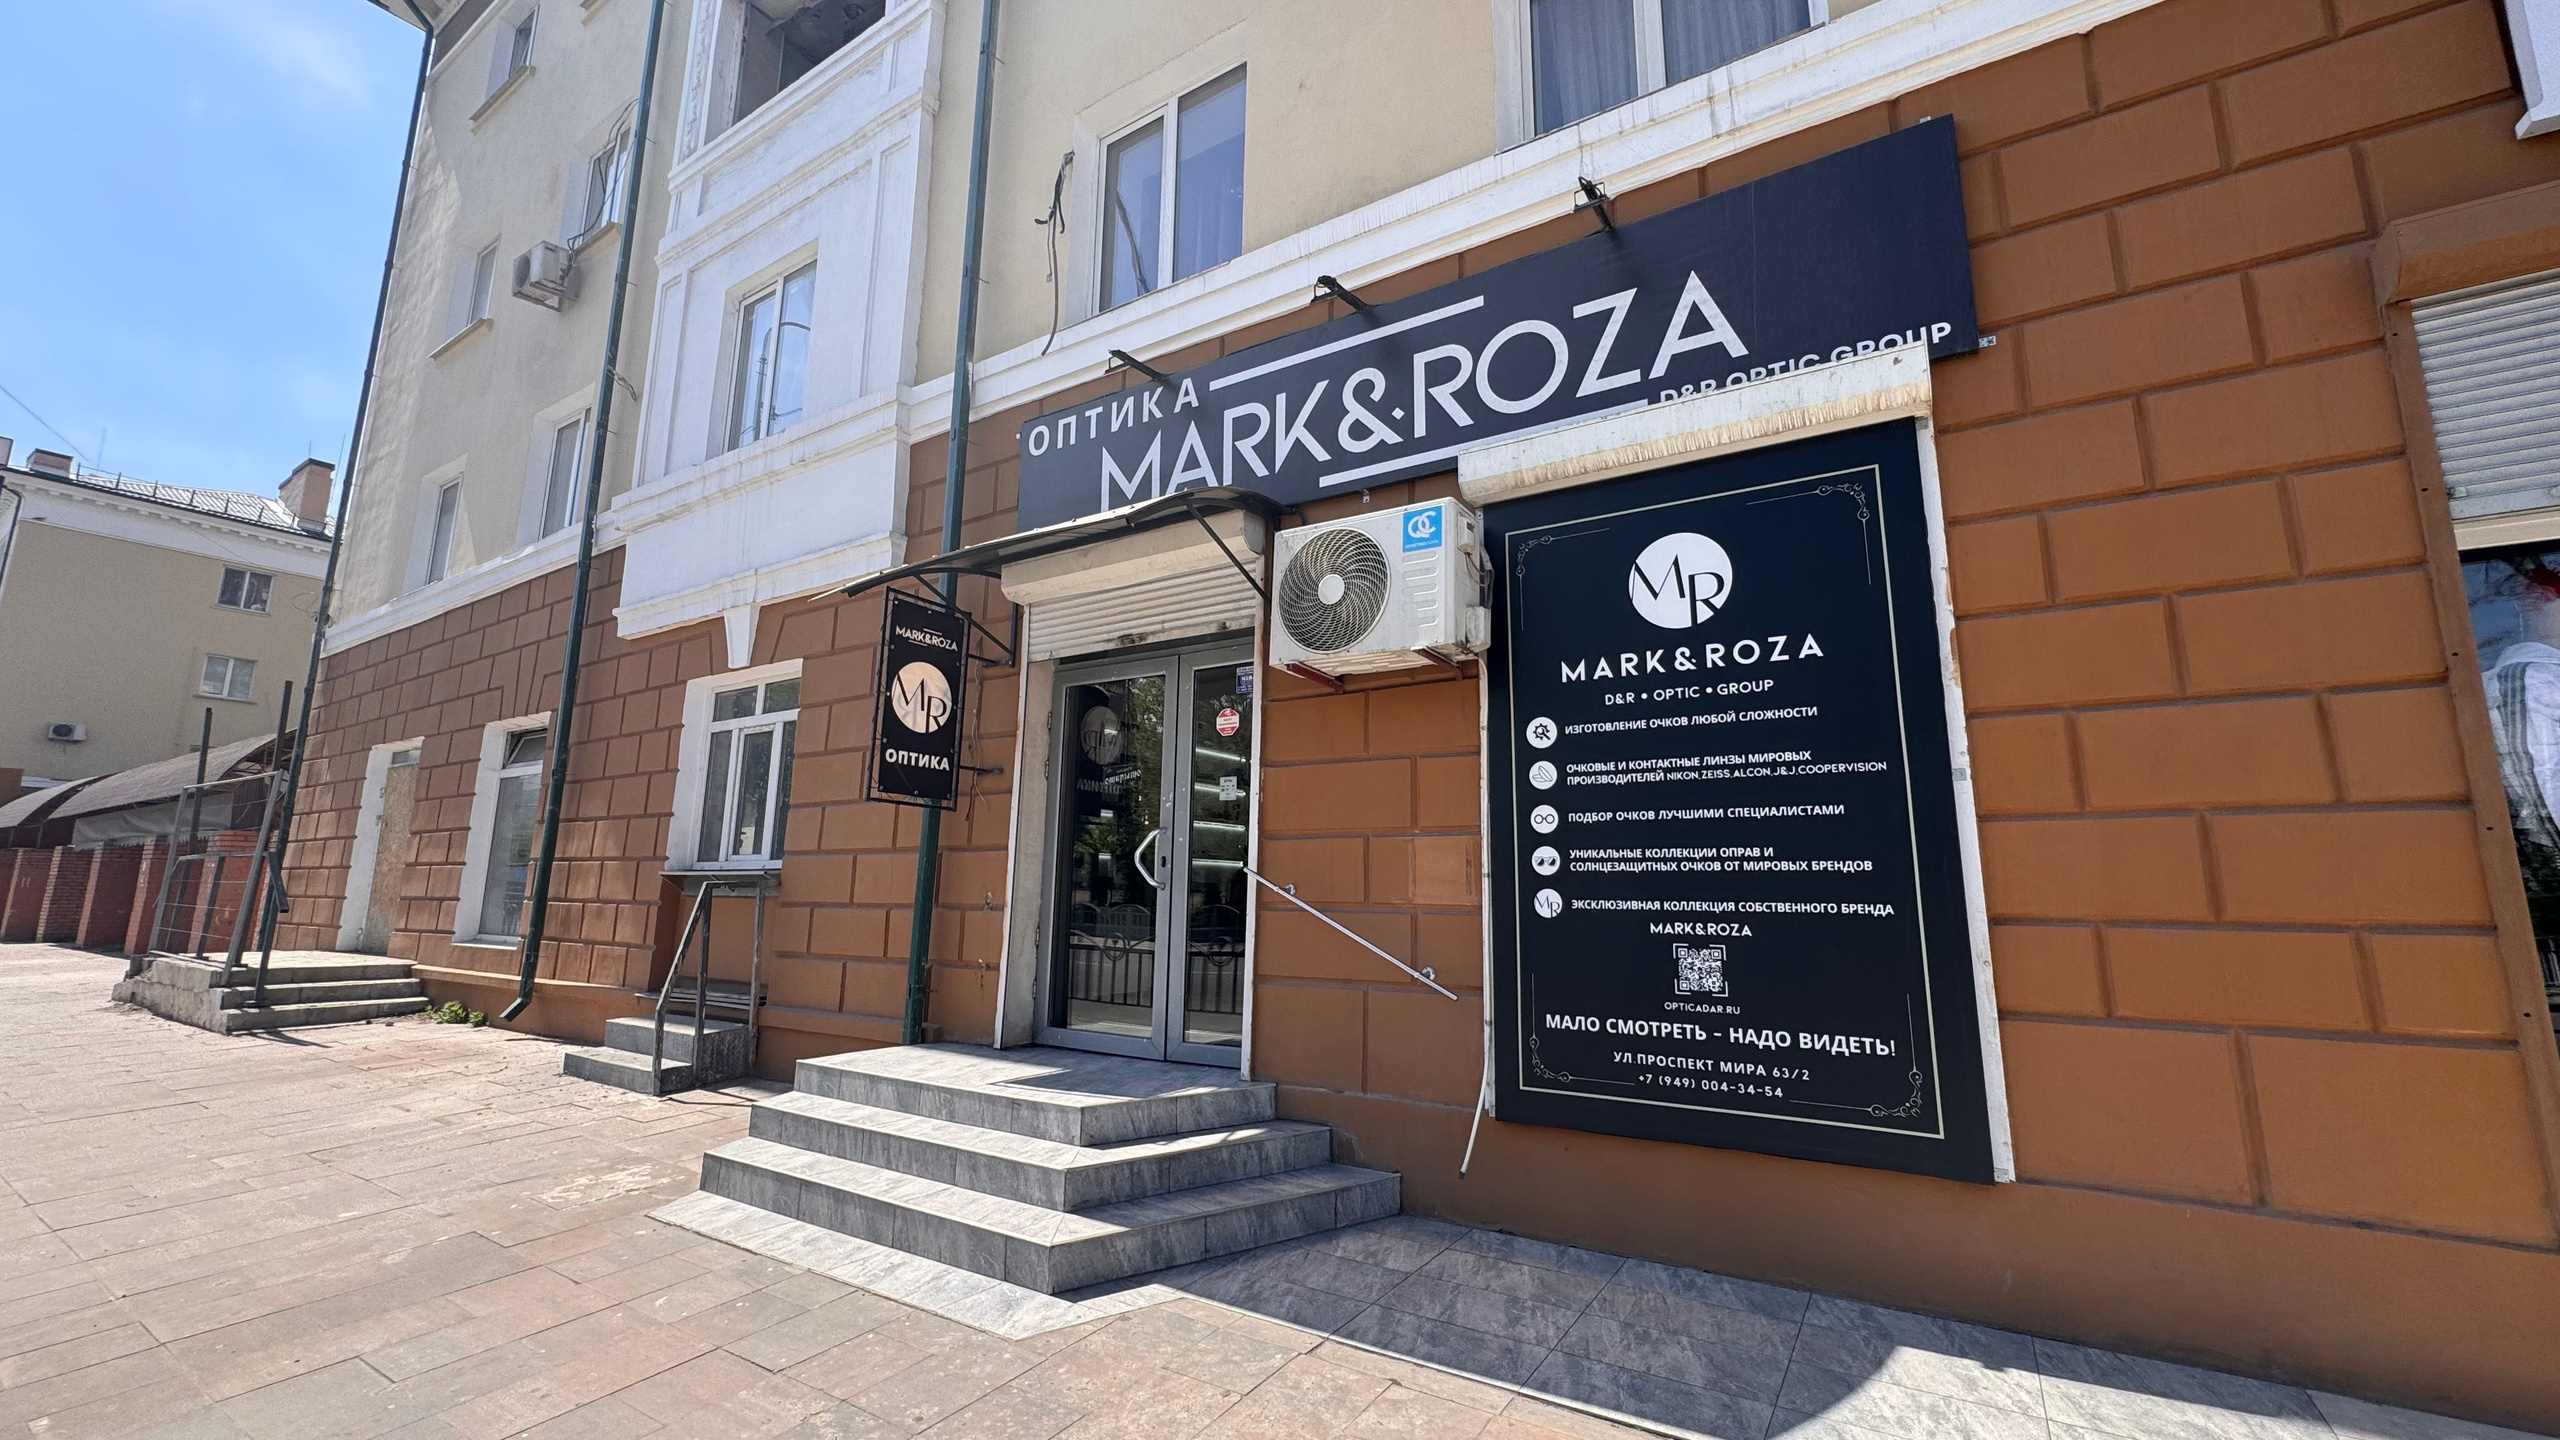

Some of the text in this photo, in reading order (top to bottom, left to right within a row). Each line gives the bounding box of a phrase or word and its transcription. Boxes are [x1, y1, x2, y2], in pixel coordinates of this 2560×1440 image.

[1101, 270, 1750, 513] MARK&ROZA
[1028, 377, 1199, 457] ОПТИКА
[895, 624, 958, 652] MARK&ROZA
[1561, 633, 1824, 683] MARK&ROZA
[1604, 679, 1774, 706] D&R OPTIC GROUP
[1564, 706, 1818, 735] ИЗГОТОВЛЕНИЕ ОЧКОВ ЛЮБОЙ СЛОЖНОСТИ
[885, 748, 950, 771] ОПТИКА
[1566, 750, 1812, 774] ОЧКОВЫЕ И КОНТАКТНЫЕ ЛИНЗЫ МИРОВЫХ
[1566, 770, 1665, 786] ПРОИЗВОДИТЕЛЕЙ
[1568, 804, 1845, 823] ПОДБОР ОЧКОВ ЛУЧШИМИ СПЕЦИАЛИСТАМИ
[1569, 847, 1774, 860] УНИКАЛЬНЫЕ КОЛЛЕКЦИИ ОПРАВ И
[1569, 860, 1873, 874] СОЛНЦЕЗАЩИТНЫХ ОЧКОВ ОТ МИРОВЫХ БРЕНДОВ
[1571, 899, 1895, 917] ЭКСКЛЮЗИВНАЯ КОЛЛЕКЦИЯ СОБСТВЕННОГО БРЕНДА
[1649, 921, 1753, 937] MARK&ROZA
[1663, 1001, 1741, 1016] OPTICADAR.RU
[1545, 1013, 1600, 1033] МАЛО
[1605, 1018, 1707, 1041] СМОТРЕТЬ
[1729, 1026, 1792, 1051] НАДО
[1798, 1032, 1897, 1057] ВИДЕТЬ!
[1719, 1060, 1767, 1077] МИРА
[1772, 1066, 1810, 1081] 63/2
[1638, 1073, 1784, 1099] +7 (949) 004-34-54
